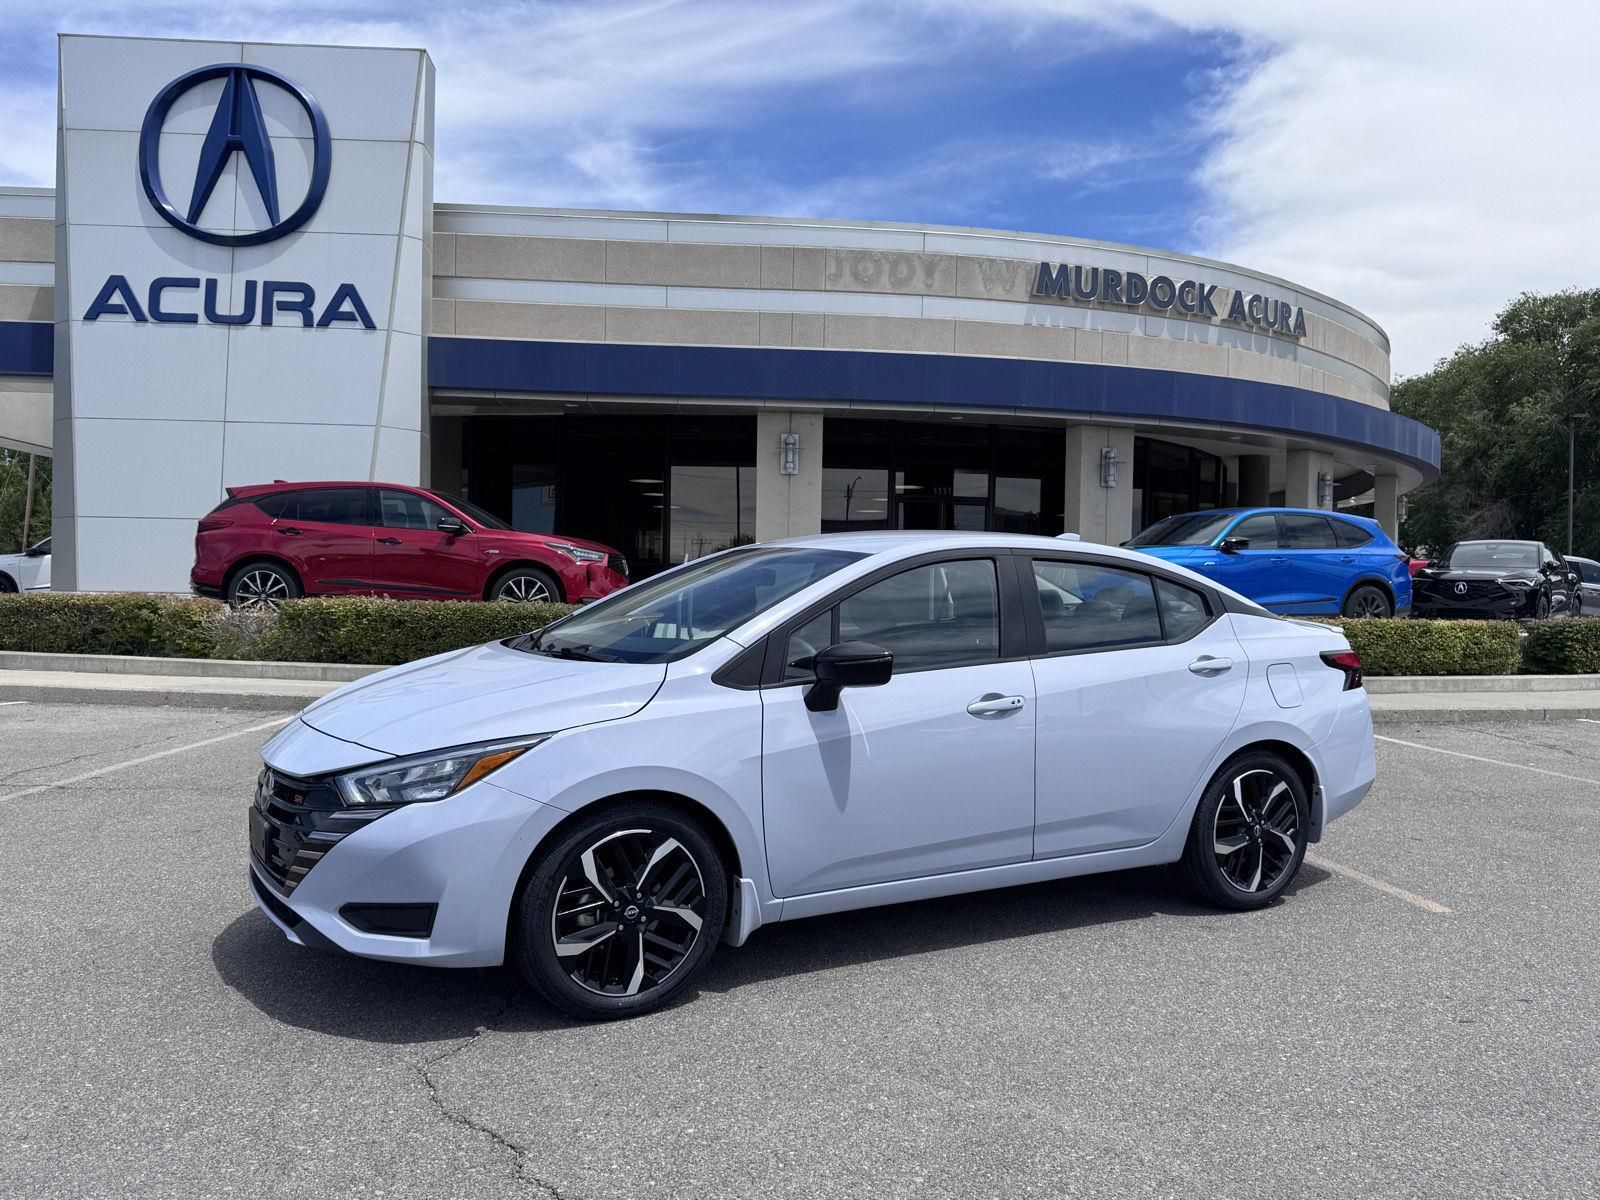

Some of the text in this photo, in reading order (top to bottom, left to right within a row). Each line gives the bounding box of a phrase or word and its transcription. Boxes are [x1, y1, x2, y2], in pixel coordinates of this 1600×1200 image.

[82, 273, 378, 329] ACURA
[976, 259, 1030, 294] W
[1035, 261, 1307, 338] MURDOCK ACURA
